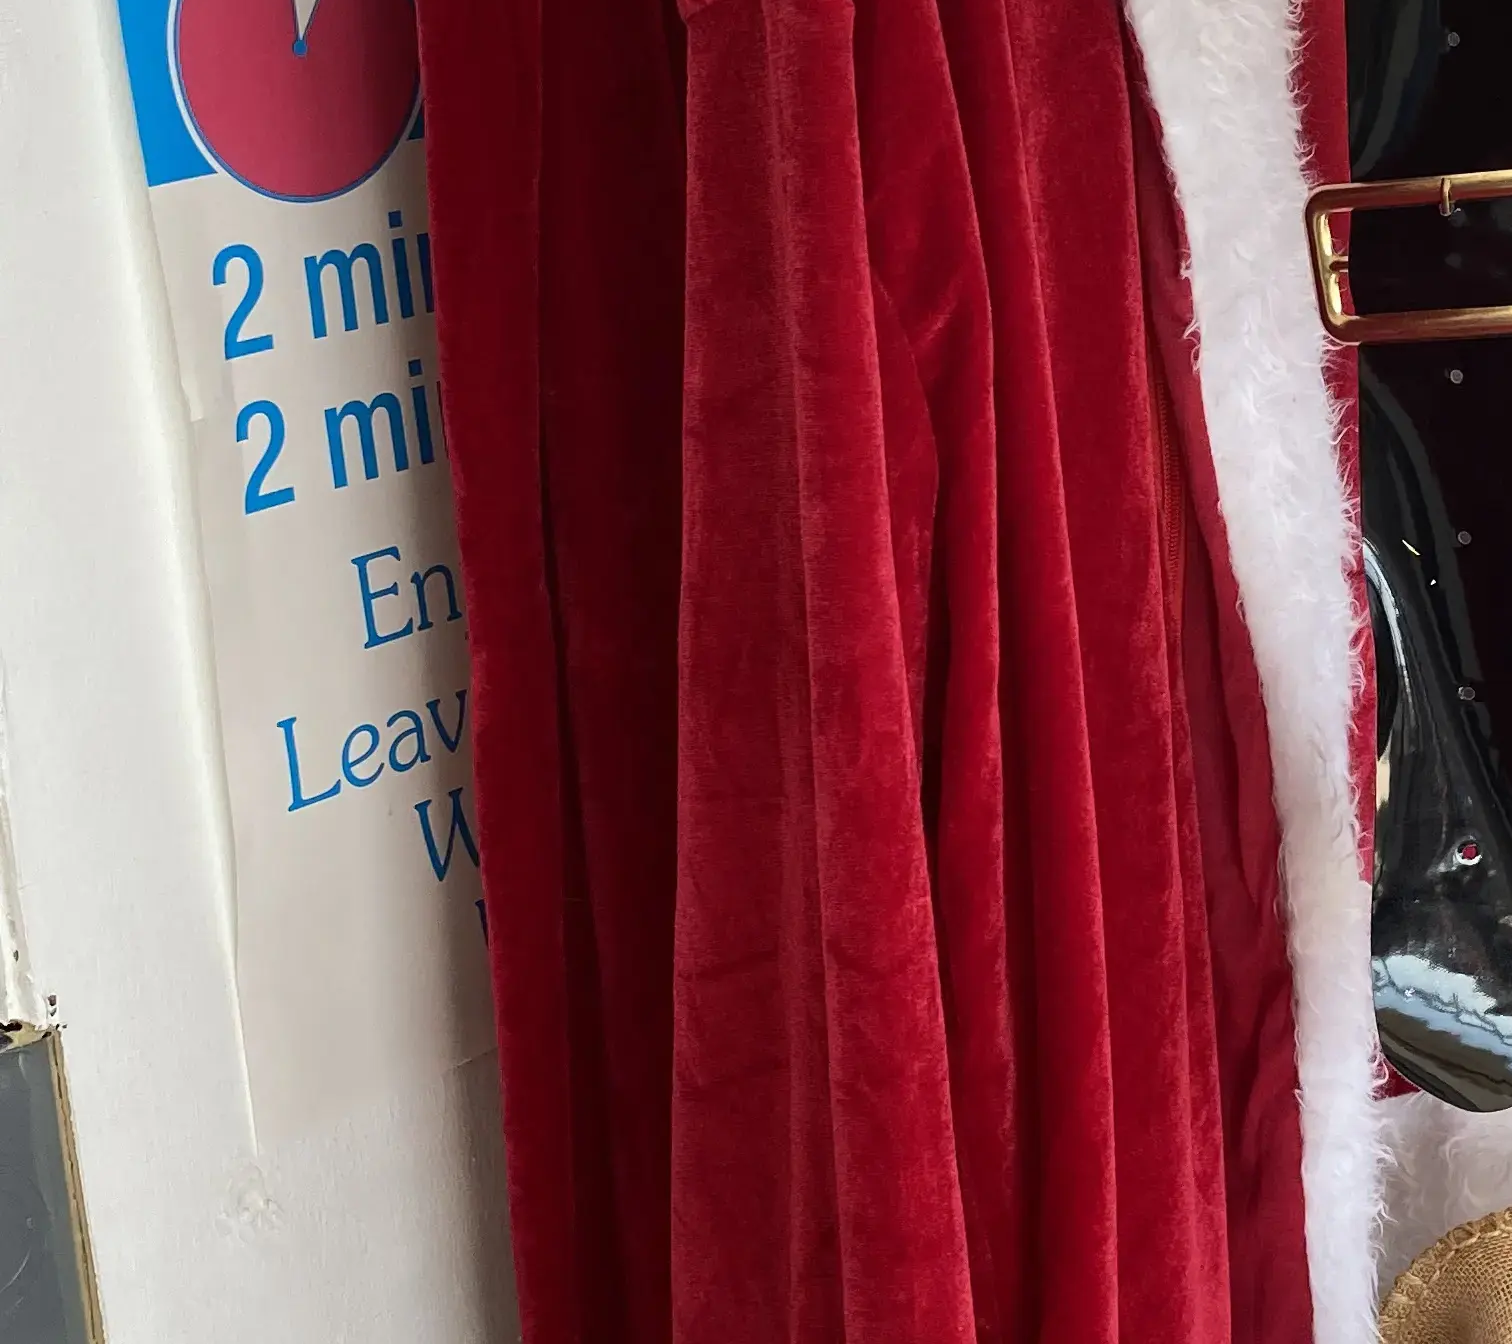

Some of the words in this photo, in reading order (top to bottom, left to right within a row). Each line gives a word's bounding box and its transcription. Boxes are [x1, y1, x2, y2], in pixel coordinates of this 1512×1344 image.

[213, 244, 274, 360] 2
[304, 210, 435, 339] mi
[236, 399, 295, 515] 2
[324, 359, 449, 488] mi
[351, 546, 468, 649] En
[277, 689, 467, 812] Leav
